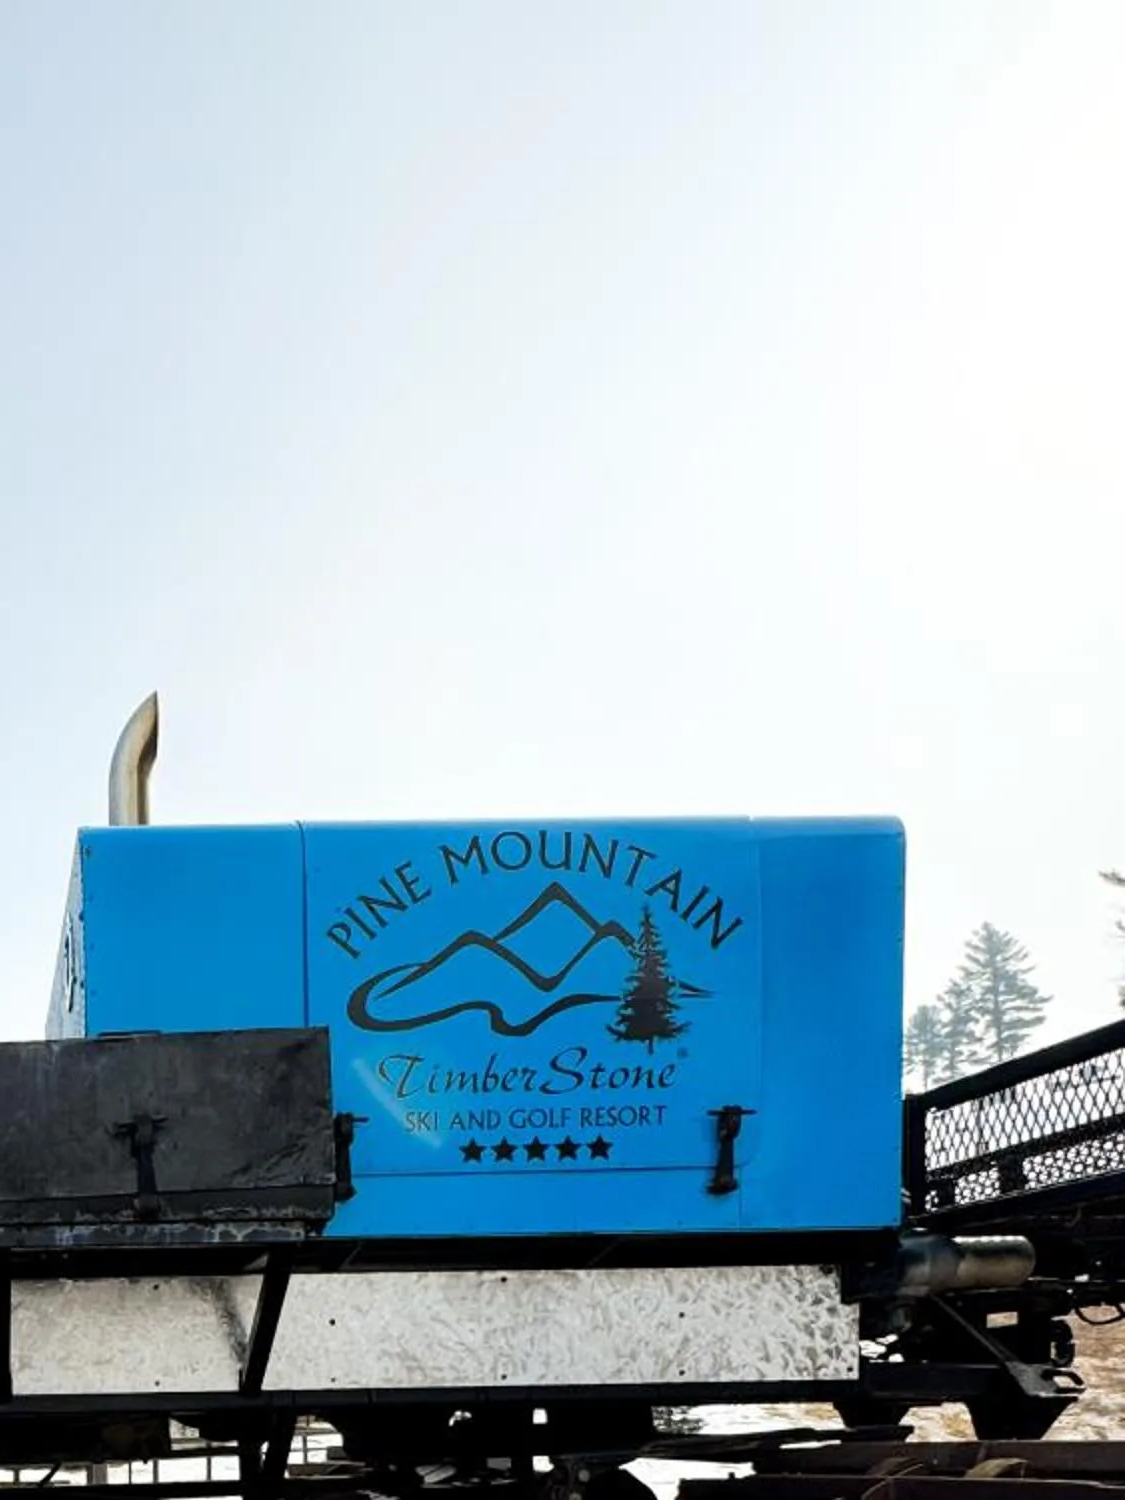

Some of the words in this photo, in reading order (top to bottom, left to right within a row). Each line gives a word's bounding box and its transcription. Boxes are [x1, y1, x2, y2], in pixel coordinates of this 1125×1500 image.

[326, 861, 432, 959] PINE
[439, 830, 742, 949] MOUNTAIN
[405, 1111, 439, 1132] SKI
[450, 1110, 501, 1131] AND
[509, 1108, 572, 1130] GOLF
[580, 1104, 668, 1127] RESORT
